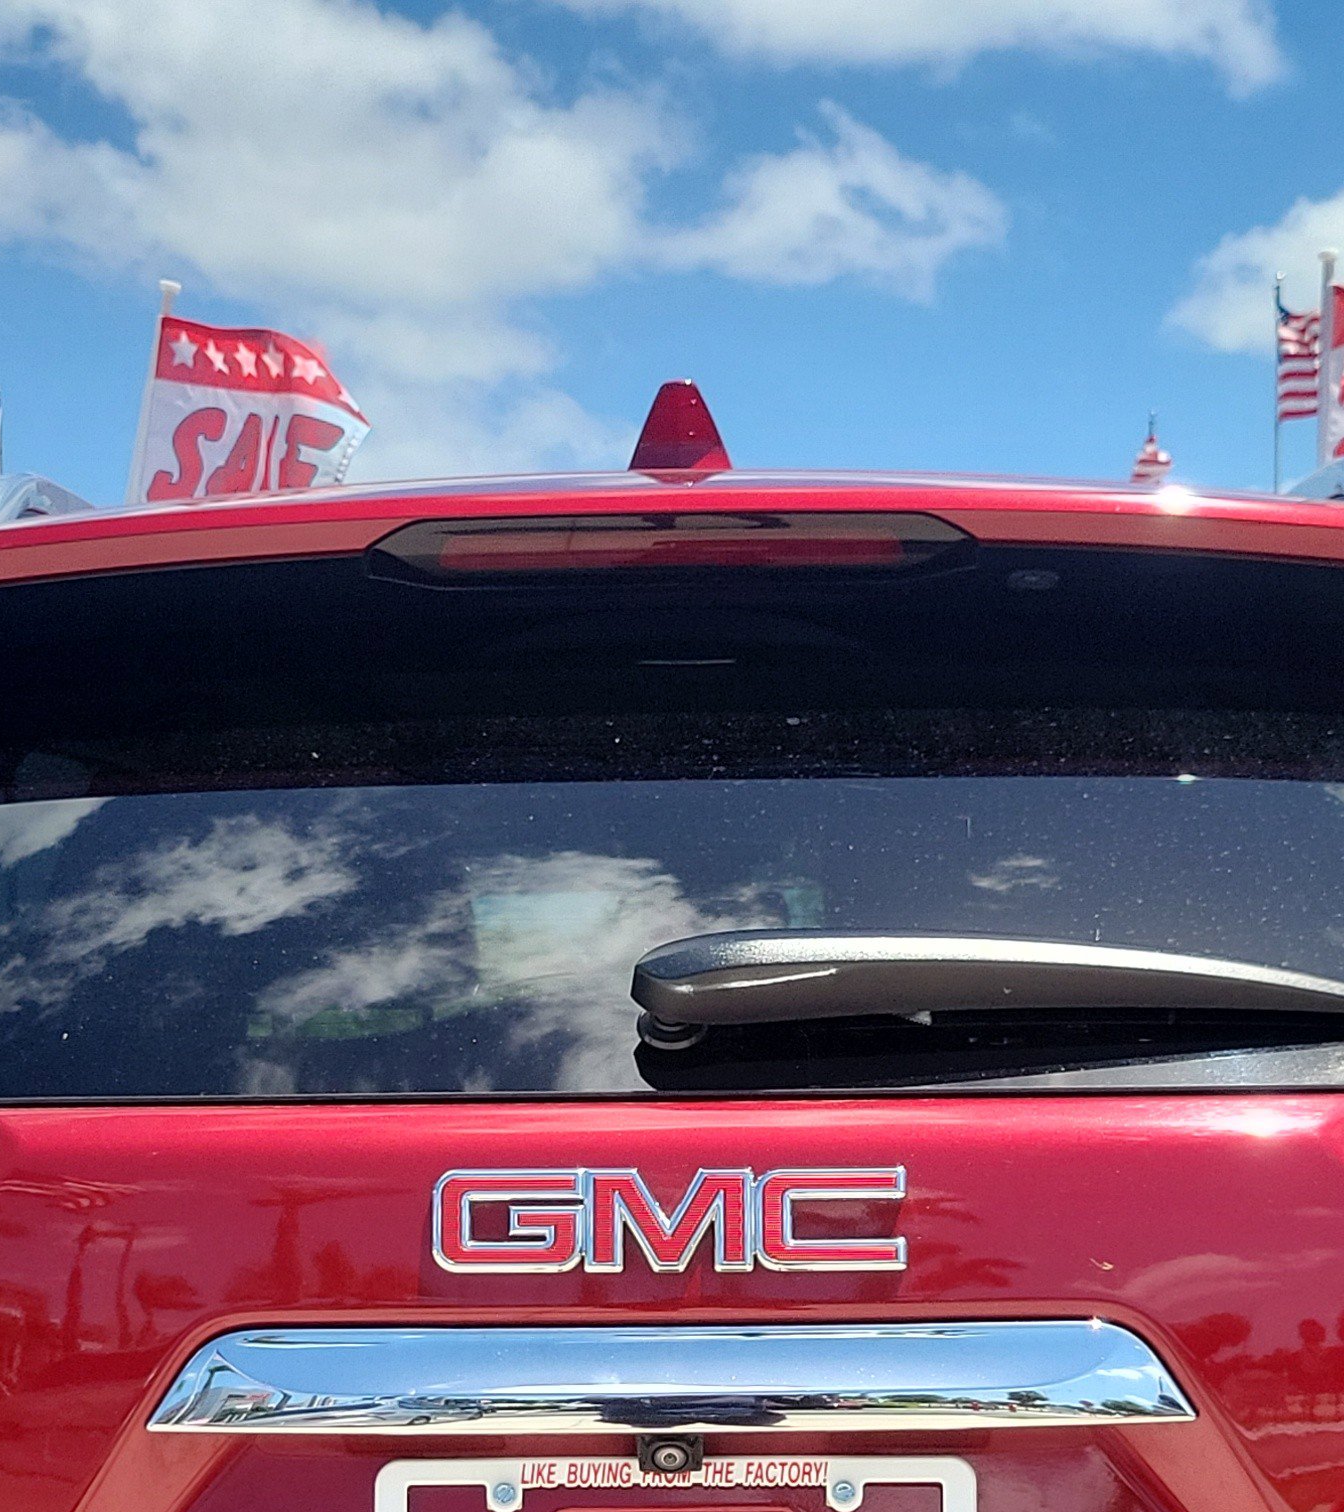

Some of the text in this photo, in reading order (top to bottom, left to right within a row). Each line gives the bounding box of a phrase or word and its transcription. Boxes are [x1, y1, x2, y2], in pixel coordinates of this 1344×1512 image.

[431, 1166, 907, 1273] GMC
[521, 1462, 556, 1484] LIKE
[567, 1462, 632, 1484] BUYING
[702, 1461, 740, 1484] THE
[743, 1461, 829, 1484] FACTORY!
